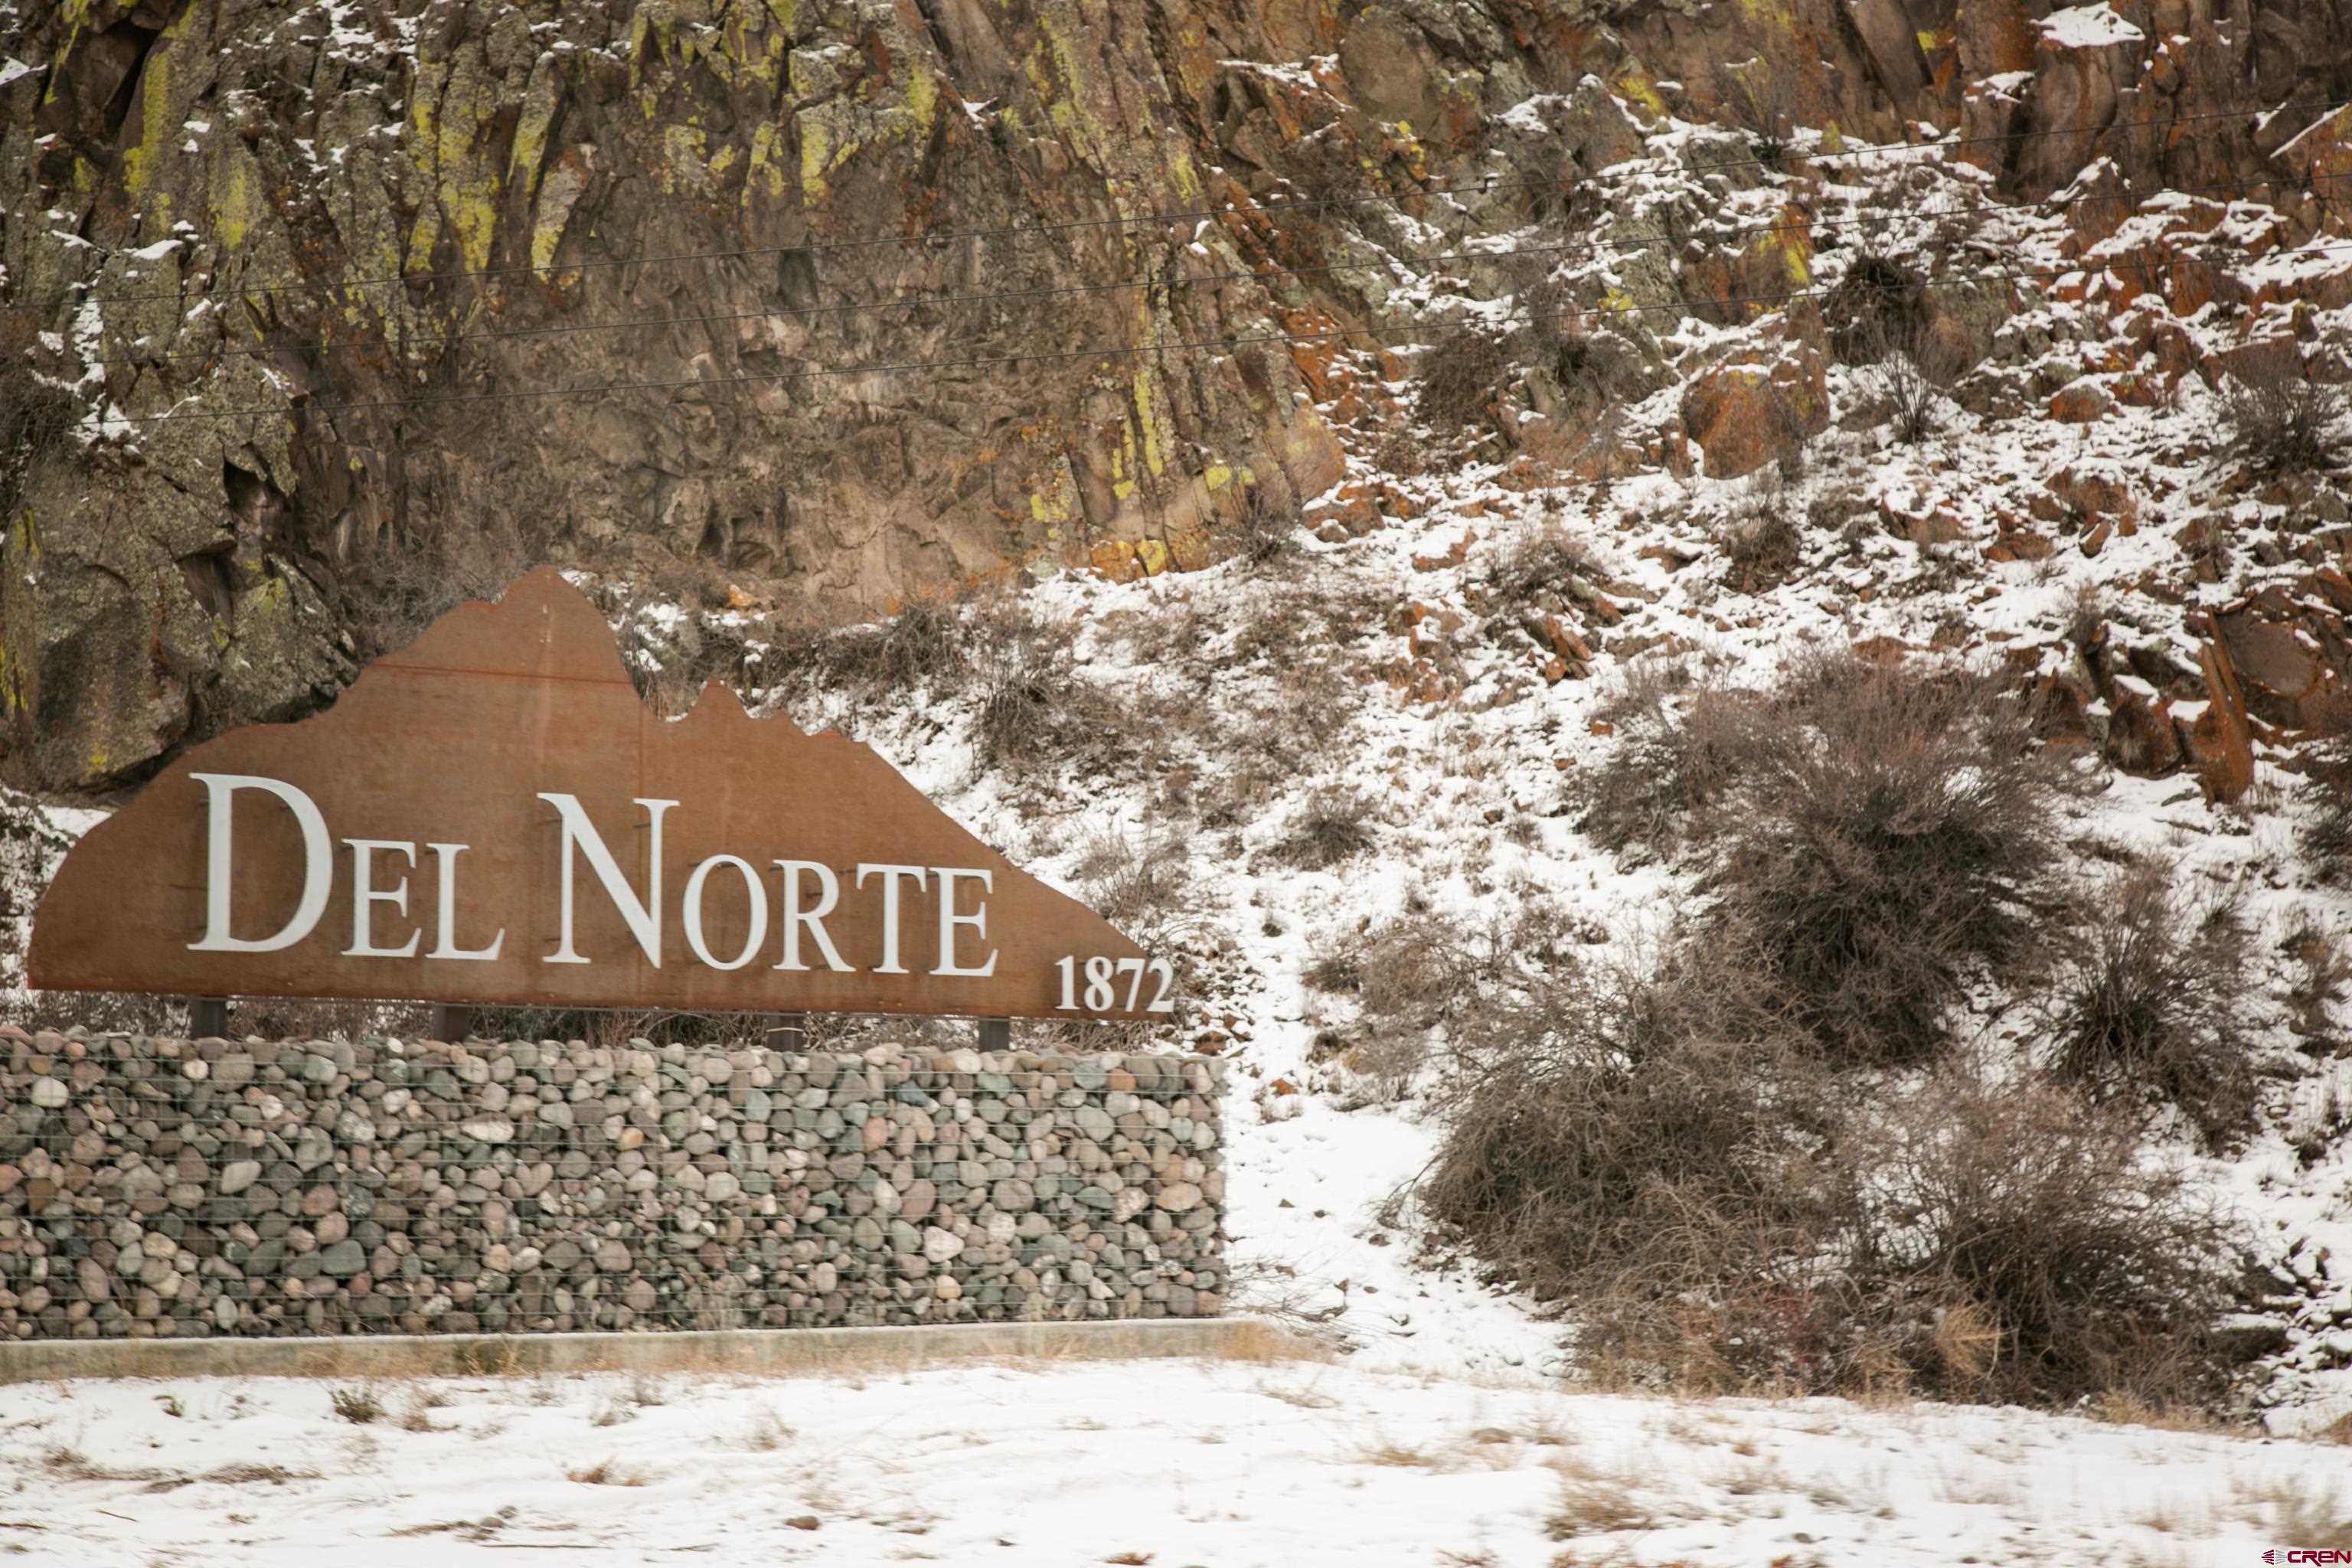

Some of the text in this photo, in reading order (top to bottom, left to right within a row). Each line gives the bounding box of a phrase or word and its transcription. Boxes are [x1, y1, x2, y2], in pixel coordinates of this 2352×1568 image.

[187, 773, 998, 978] DEL NORTE
[1054, 955, 1175, 1012] 1872
